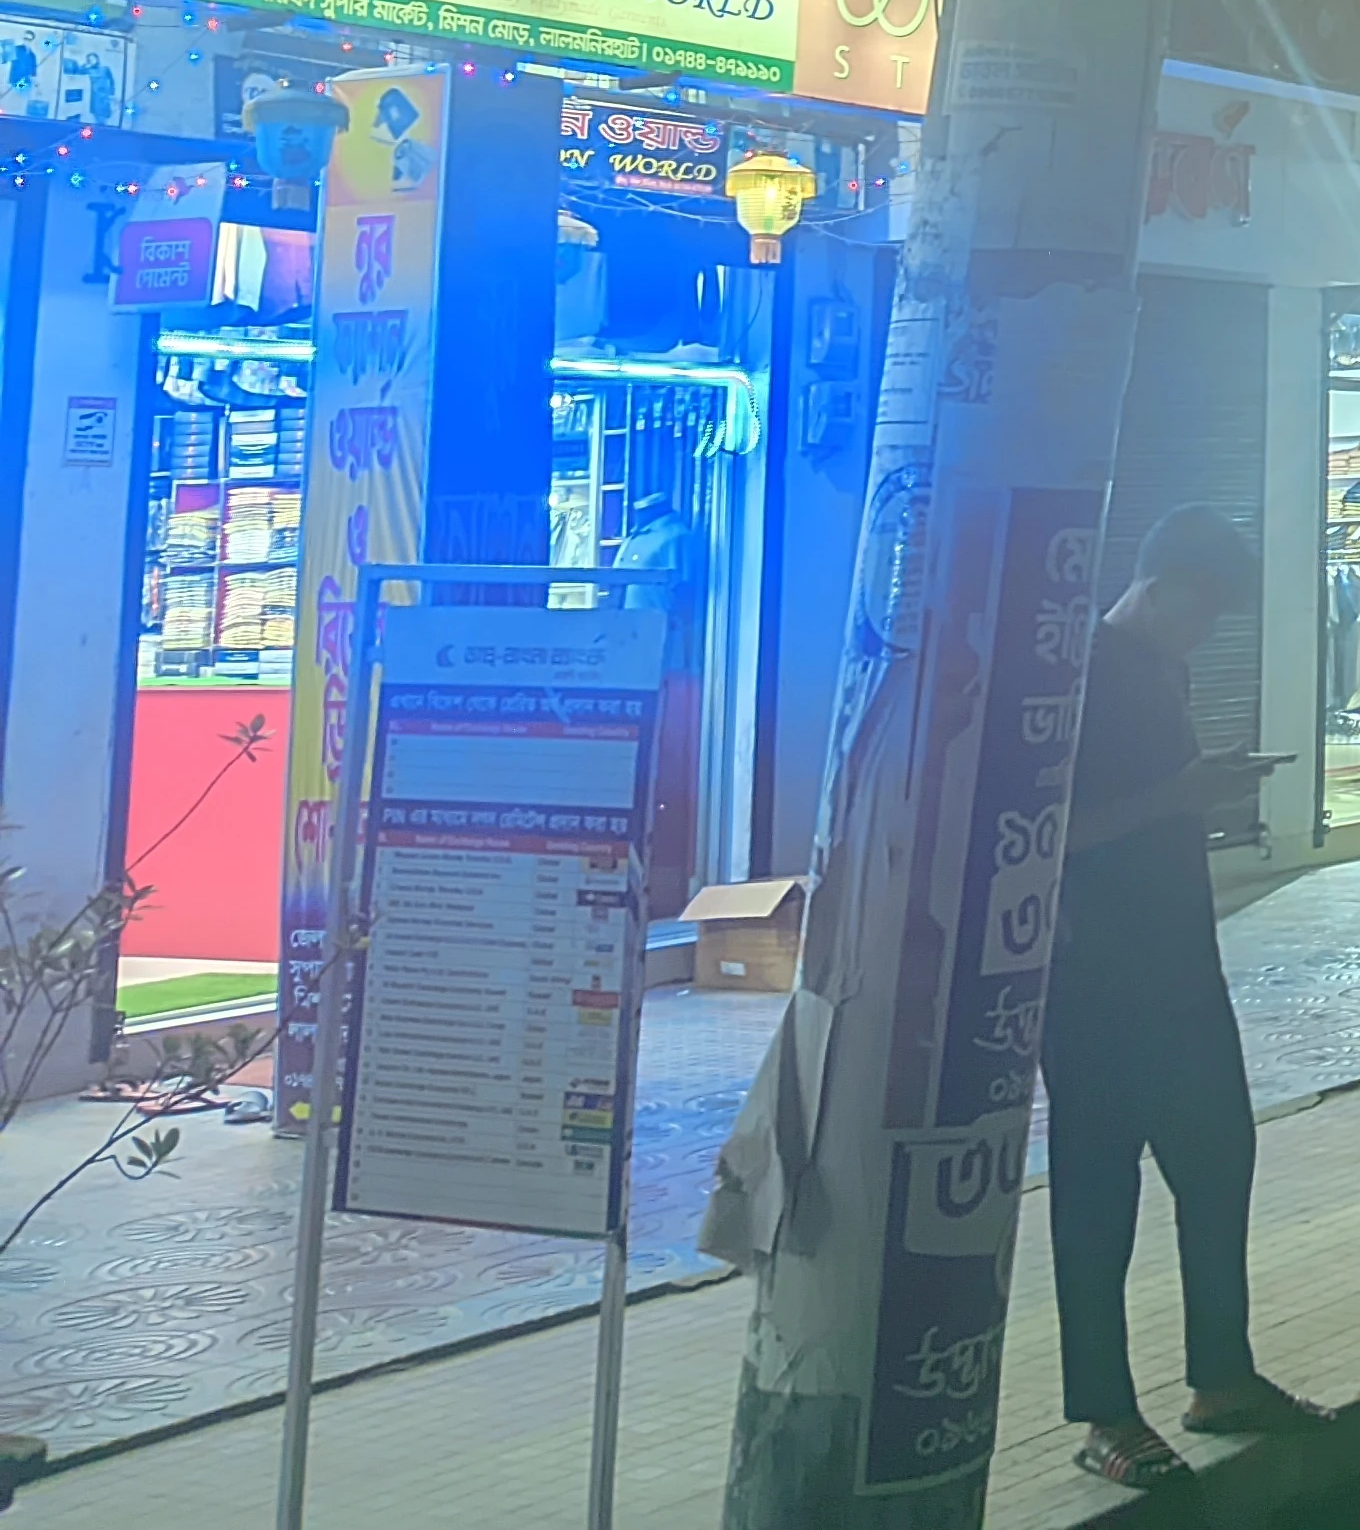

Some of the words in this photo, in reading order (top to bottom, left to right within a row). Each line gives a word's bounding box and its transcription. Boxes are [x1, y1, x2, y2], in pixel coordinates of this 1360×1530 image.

[438, 5, 485, 37] মিশন
[609, 153, 717, 181] WORLD
[140, 236, 191, 261] বিকাশ
[355, 214, 396, 306] নুর
[135, 262, 191, 289] পেমেন্ট
